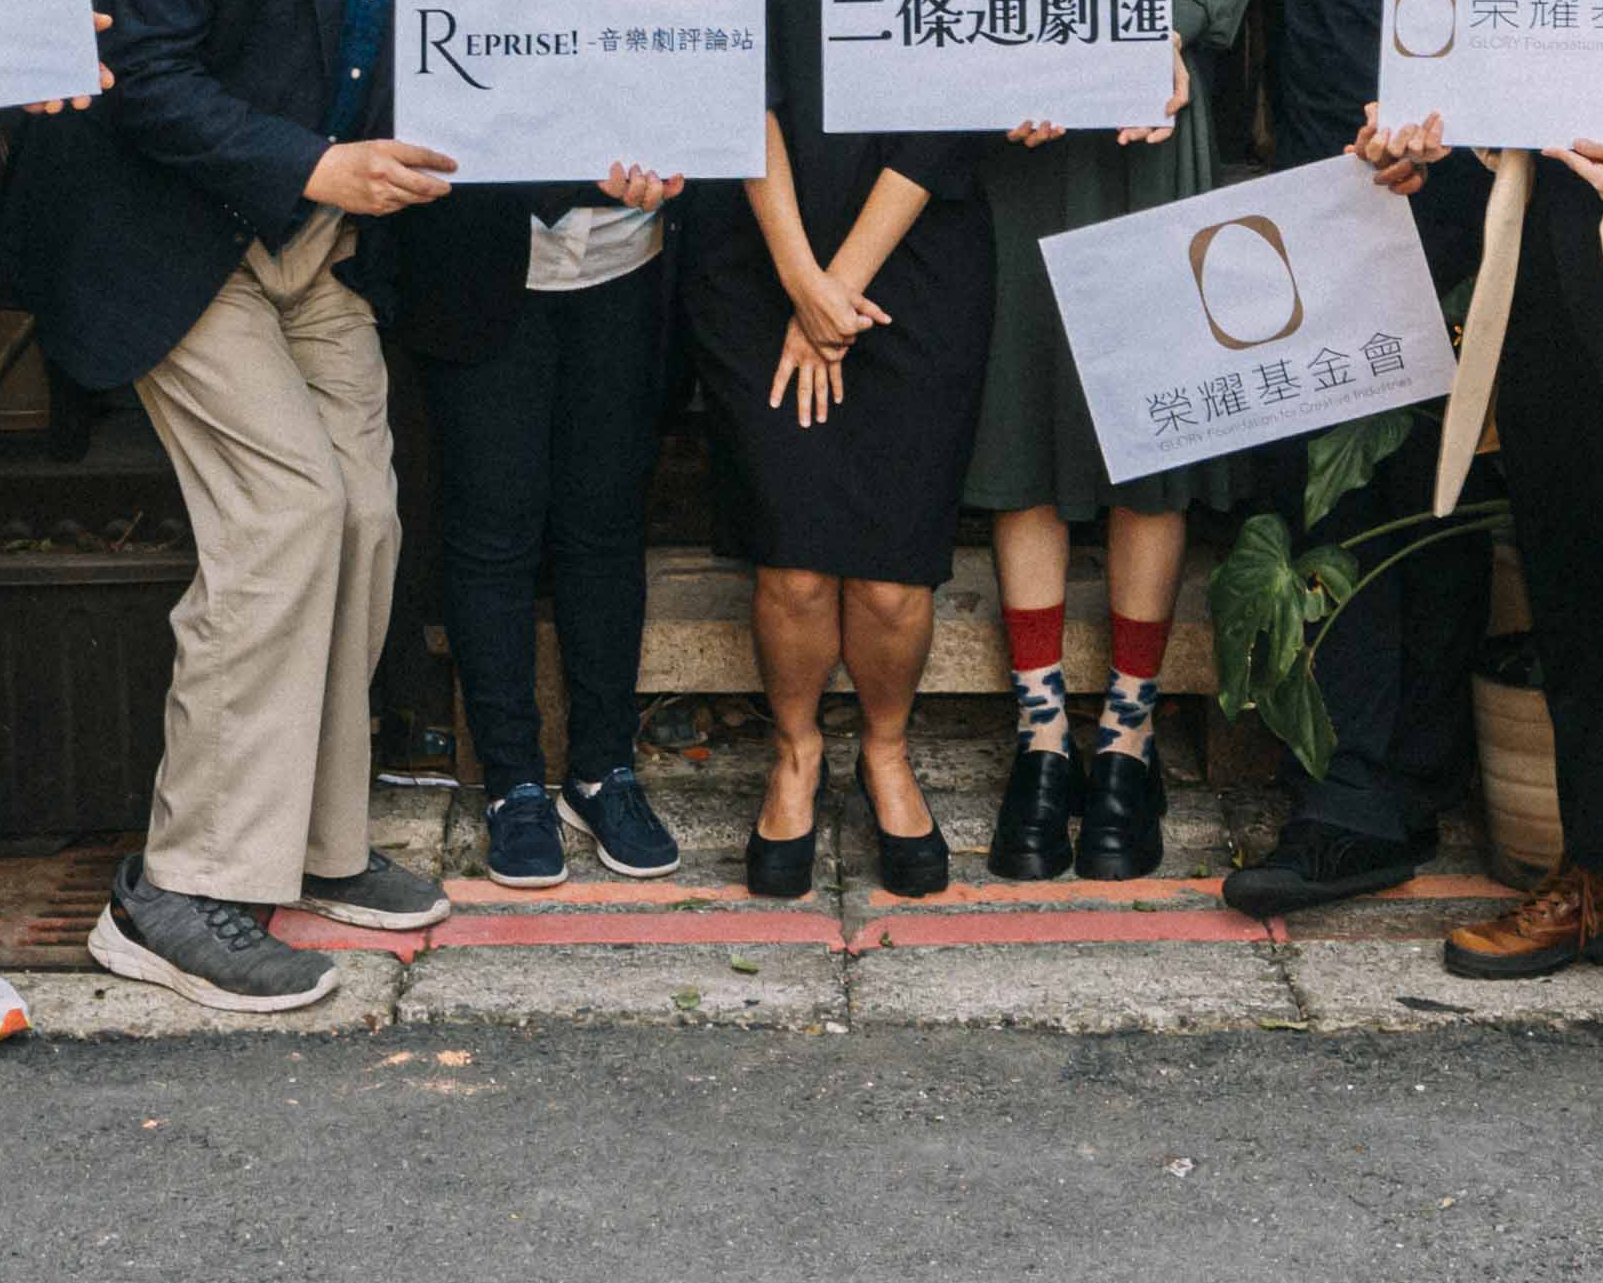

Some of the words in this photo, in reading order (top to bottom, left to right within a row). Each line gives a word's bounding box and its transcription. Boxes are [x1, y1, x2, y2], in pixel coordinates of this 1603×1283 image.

[1146, 332, 1405, 436] 榮耀基金會
